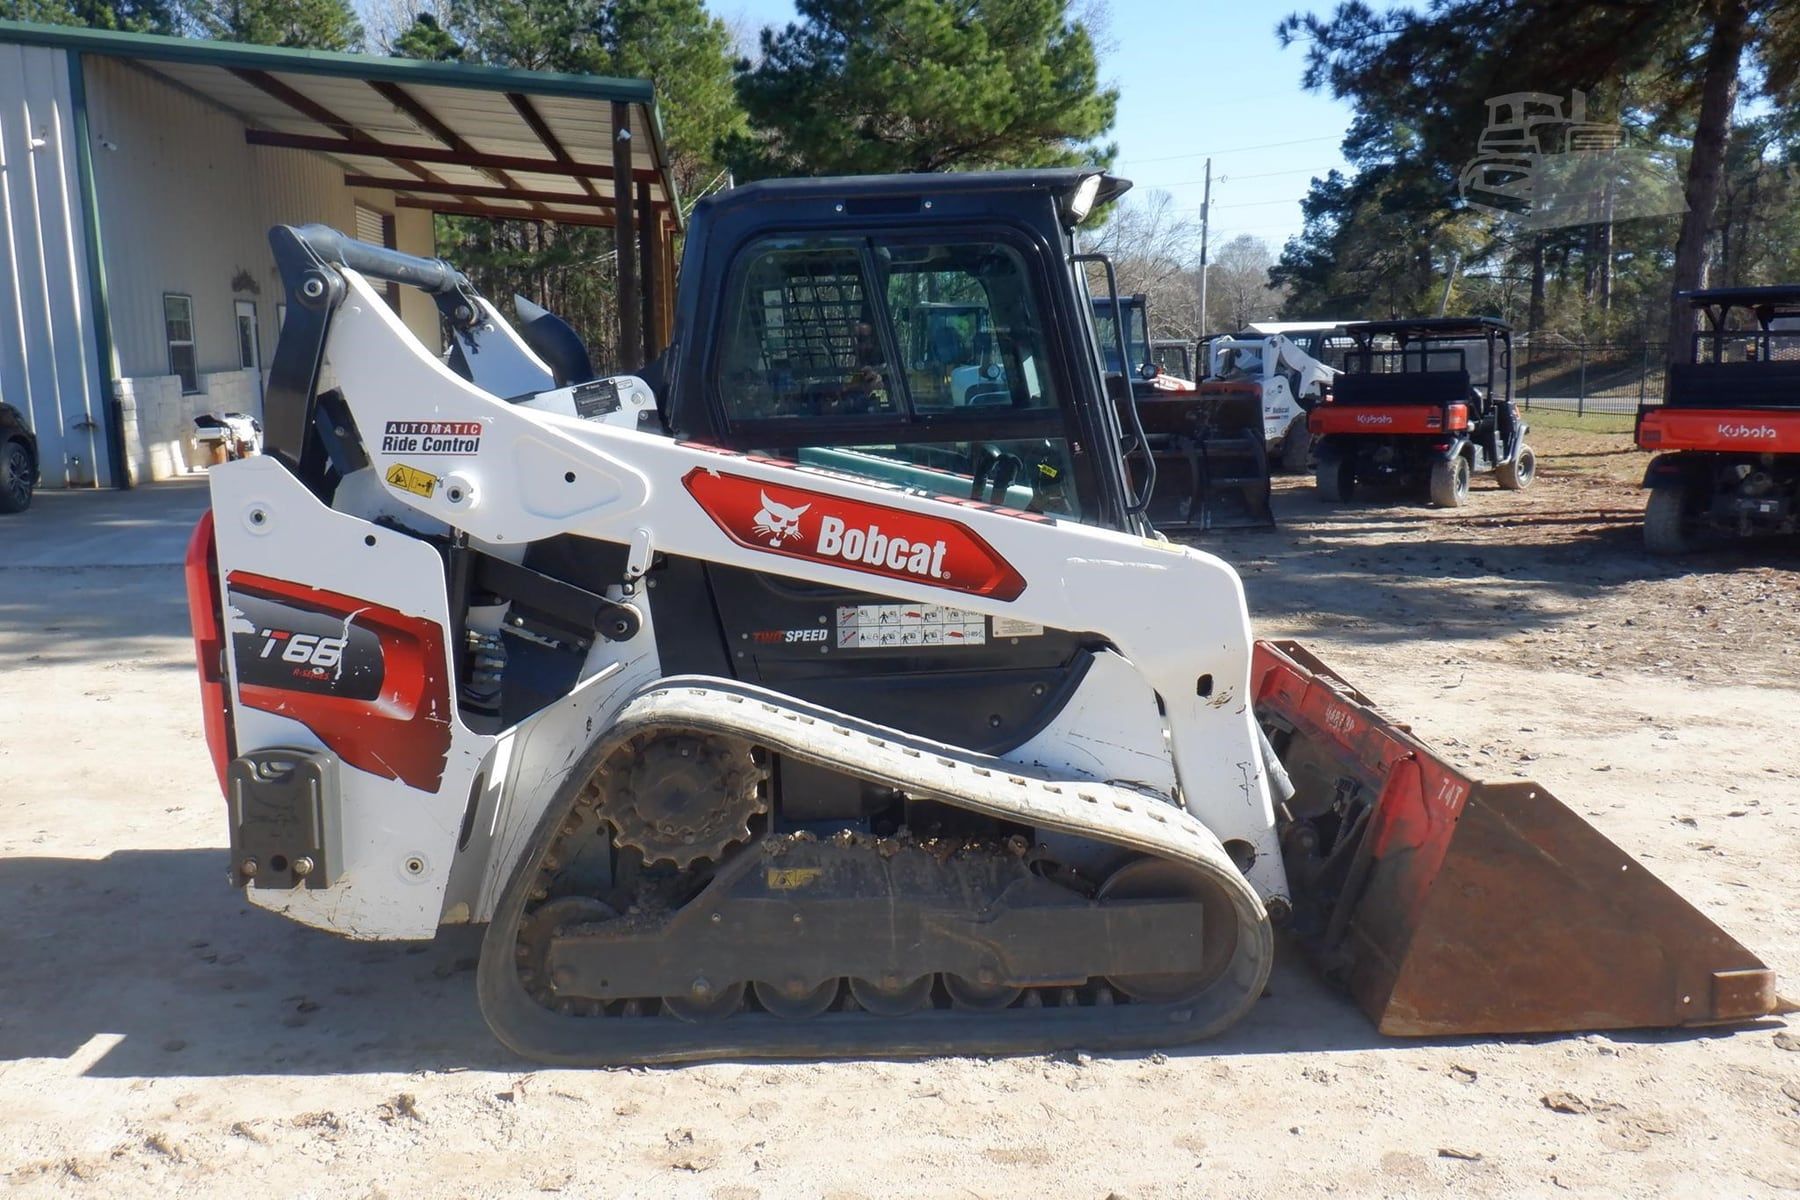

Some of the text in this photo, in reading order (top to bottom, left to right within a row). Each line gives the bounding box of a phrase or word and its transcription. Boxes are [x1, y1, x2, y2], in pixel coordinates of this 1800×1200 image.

[1357, 414, 1392, 424] Kubota
[389, 423, 479, 434] AUTOMATIC
[1718, 424, 1776, 438] Kubota
[382, 436, 480, 452] Ride Control
[816, 515, 947, 579] Bobcat
[785, 629, 828, 642] SPEED
[260, 629, 348, 667] T66
